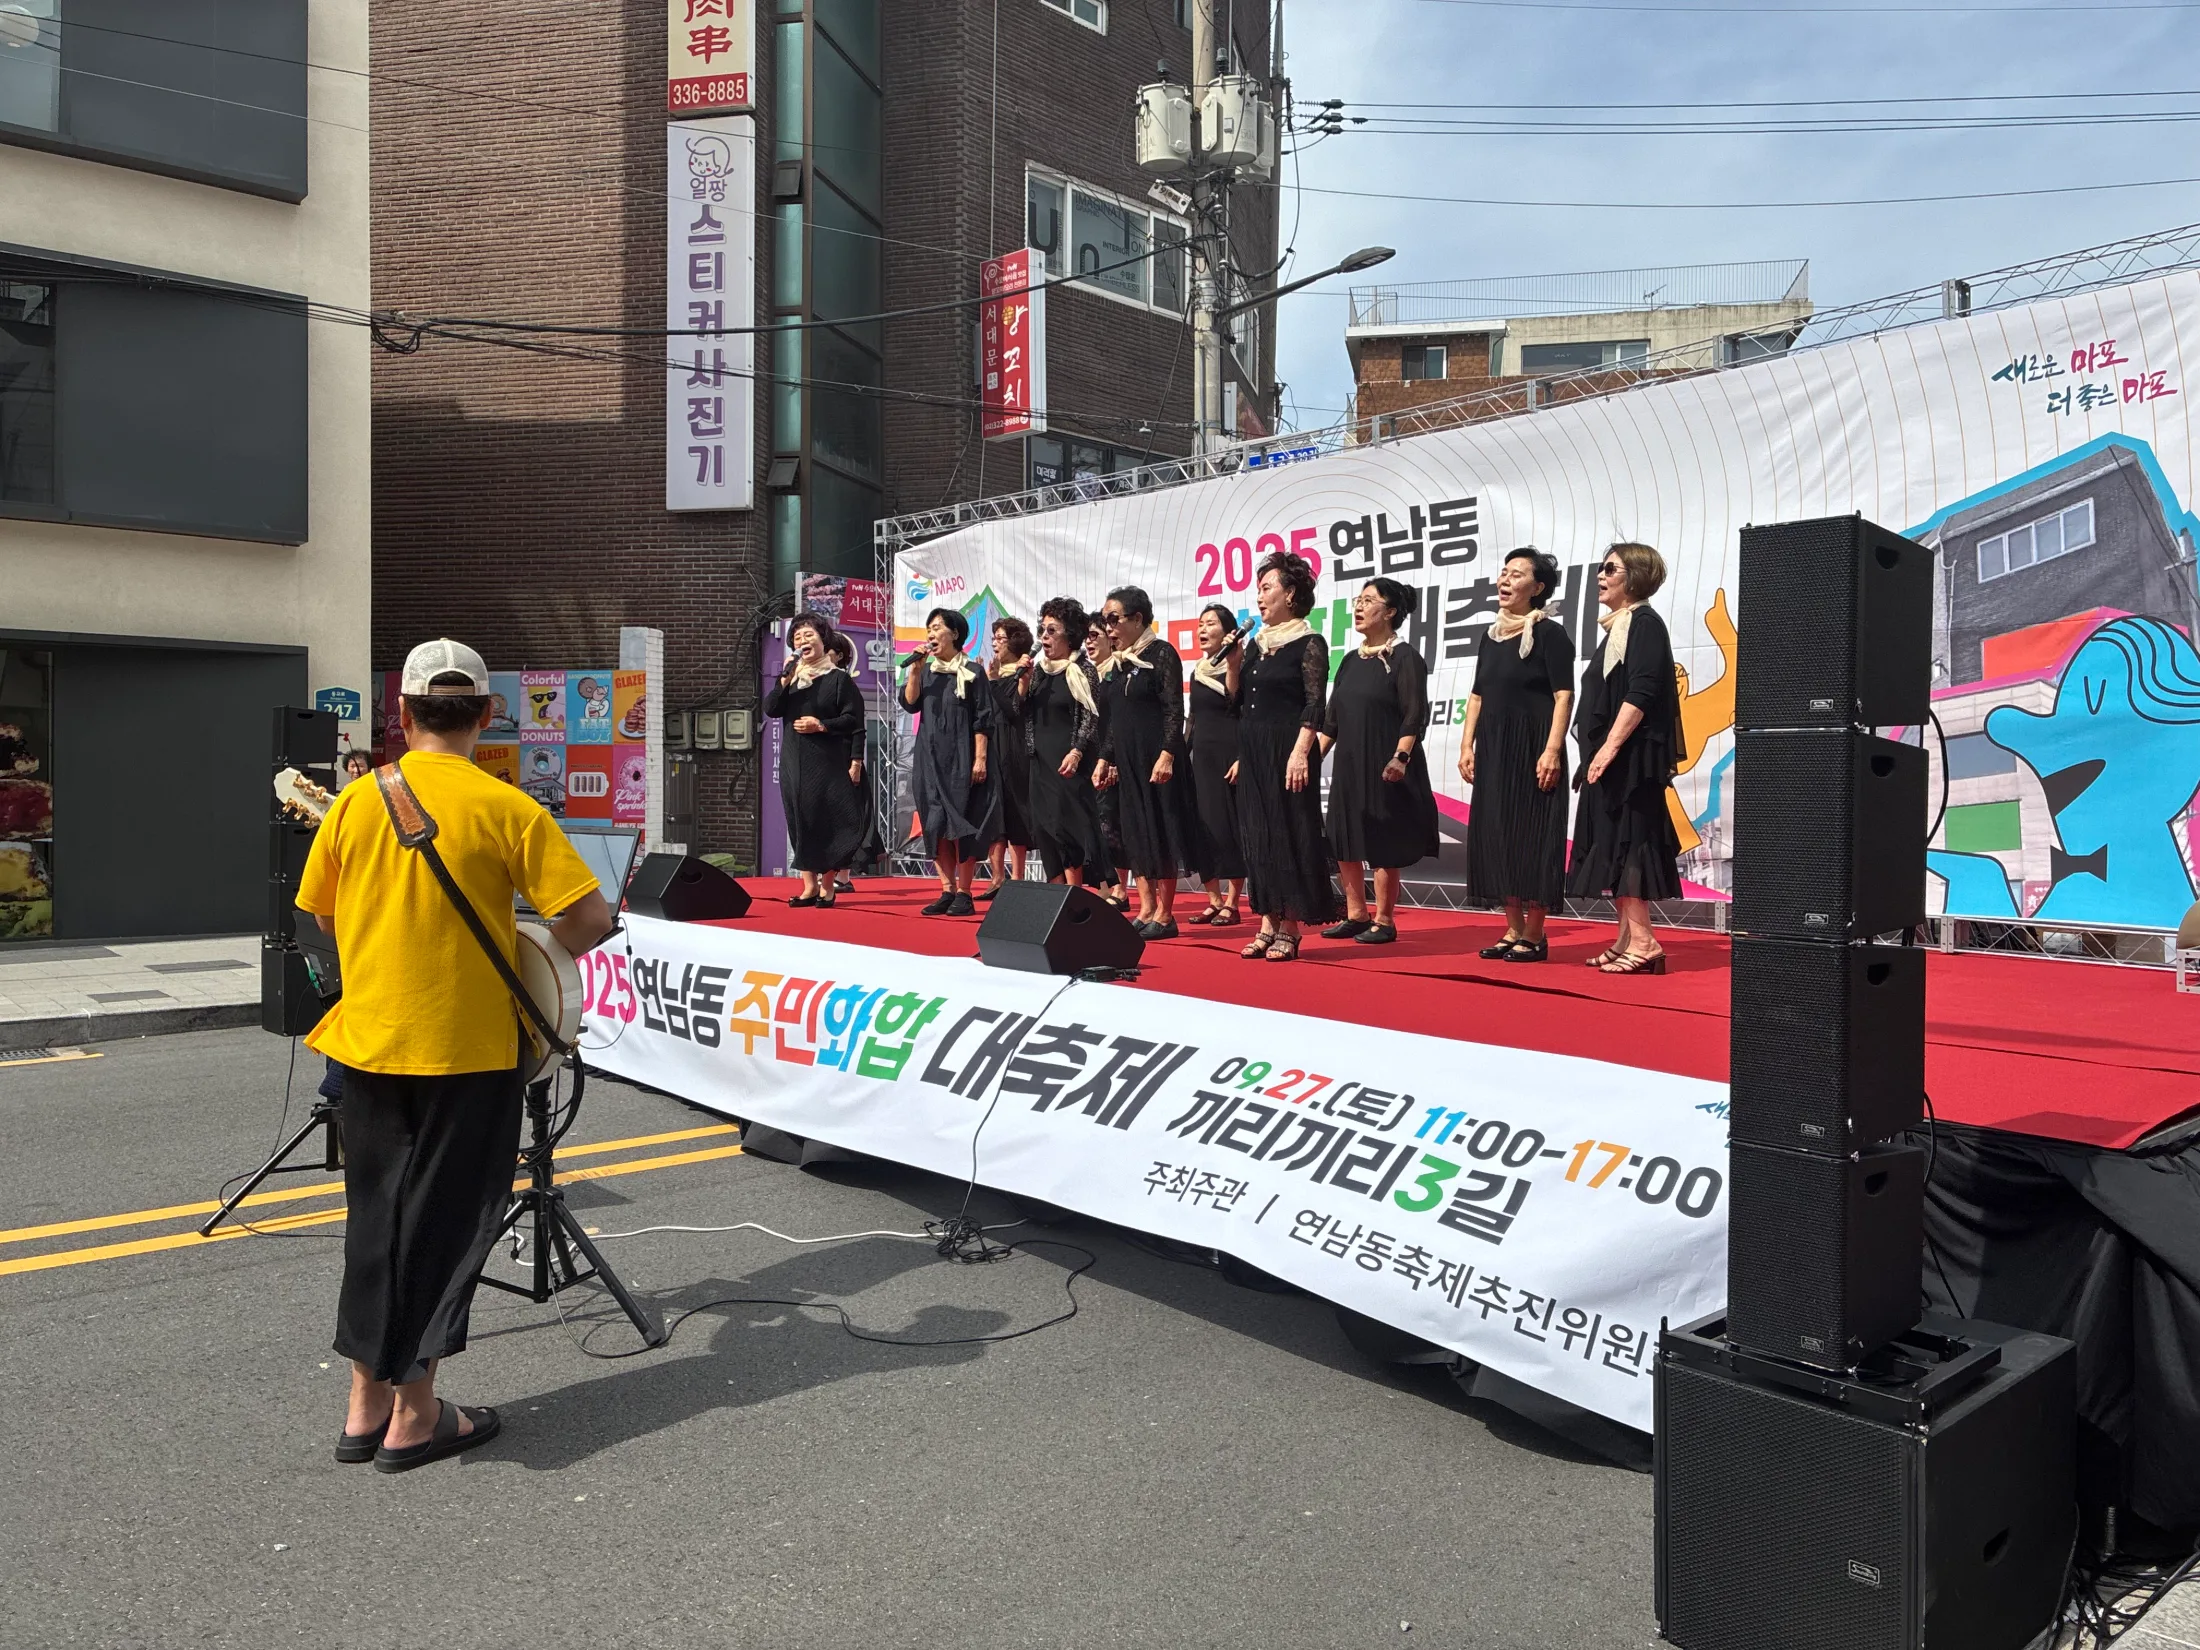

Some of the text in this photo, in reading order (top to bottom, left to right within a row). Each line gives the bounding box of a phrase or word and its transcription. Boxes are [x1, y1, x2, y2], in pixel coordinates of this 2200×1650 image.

[673, 78, 744, 105] 336-8885
[690, 177, 727, 202] 얼짱
[1103, 240, 1130, 257] INTERIOR
[687, 203, 727, 487] 스티커사진기
[984, 304, 998, 367] 서대문
[1002, 304, 1029, 407] 양꼬치
[1991, 339, 2129, 385] 새로운 마포
[2046, 370, 2178, 416] 더 좋은 마포
[1329, 496, 1480, 582] 연남동
[934, 575, 965, 597] MAPO
[522, 674, 565, 685] Colorful
[323, 704, 353, 718] 247
[579, 718, 610, 730] FAT
[522, 732, 565, 742] DONUTS
[614, 789, 643, 805] Pink
[575, 949, 1200, 1131] 025 연남동 주민화합 대축제
[1210, 1057, 1723, 1218] 09.27.(토) 11:00-17:00
[1165, 1089, 1532, 1246] 끼리끼리3길
[1143, 1161, 1250, 1213] 주최주관
[1288, 1209, 1654, 1378] 연남동축제추진위원
